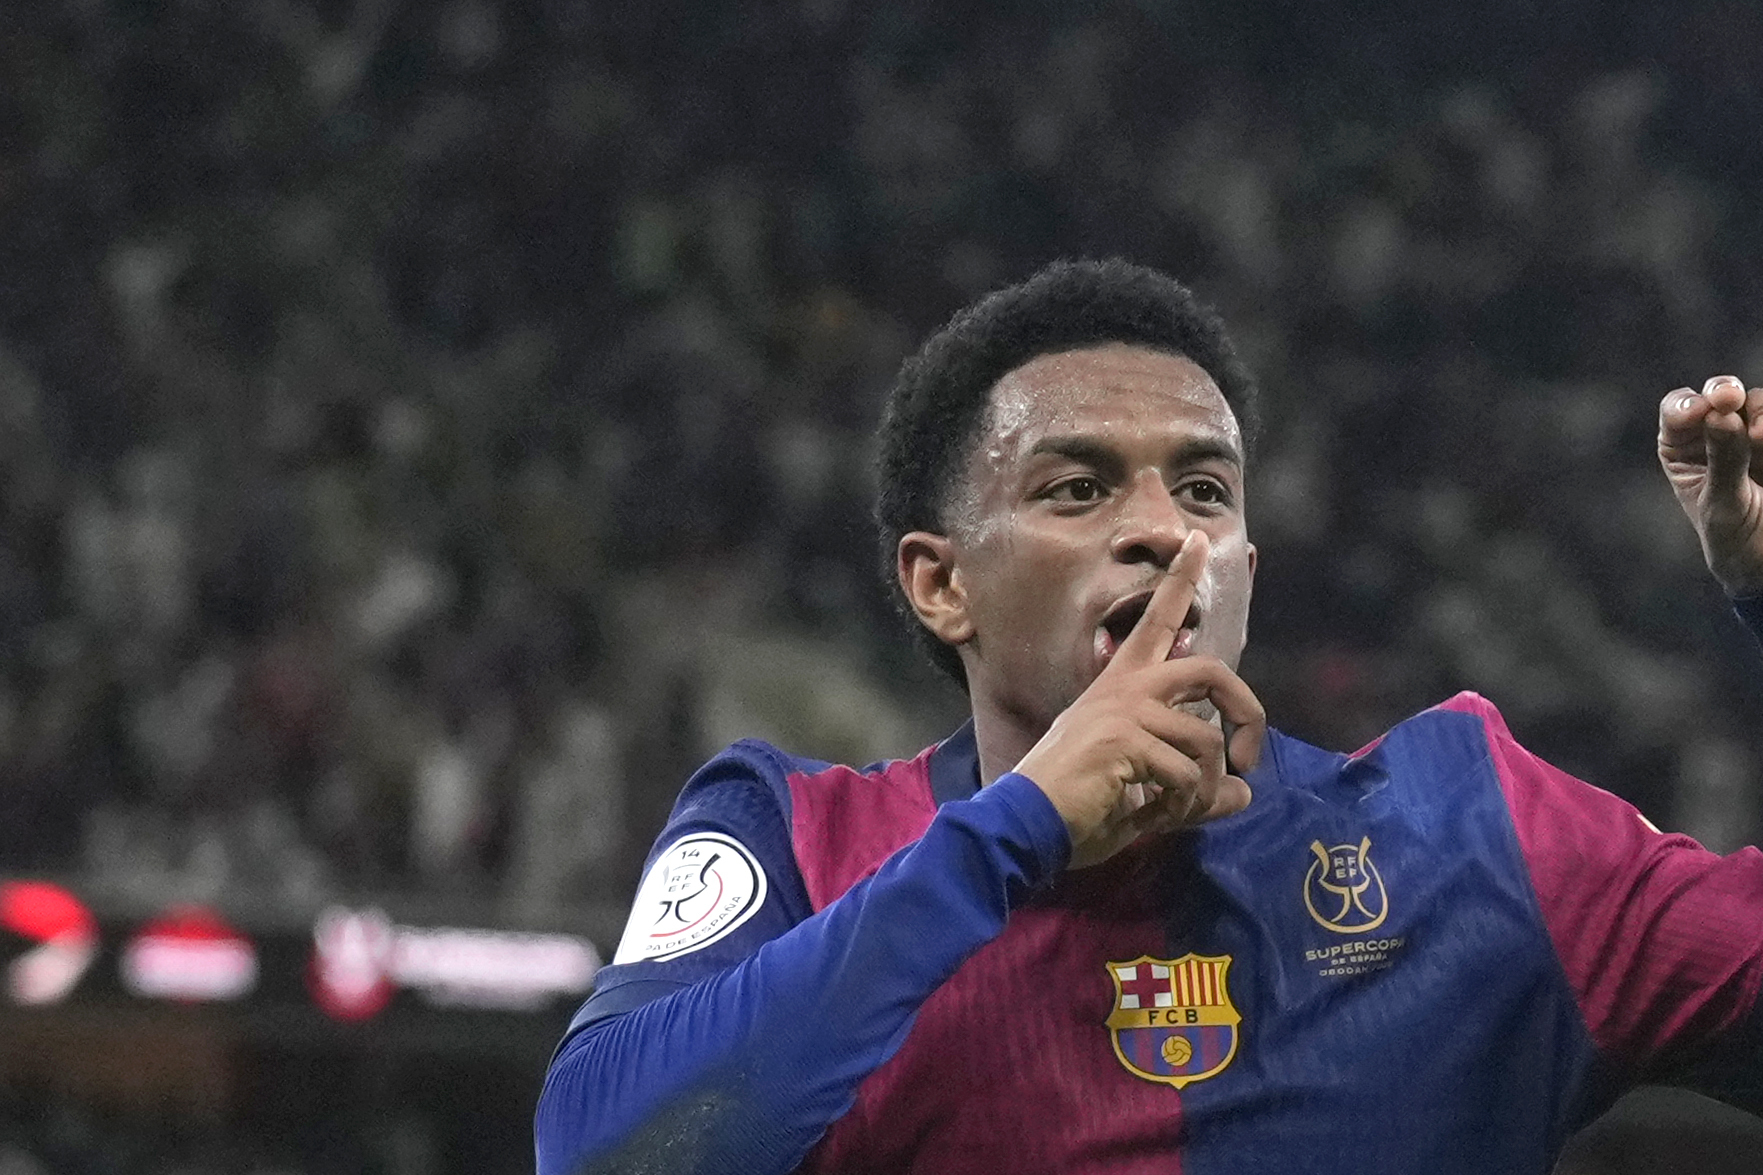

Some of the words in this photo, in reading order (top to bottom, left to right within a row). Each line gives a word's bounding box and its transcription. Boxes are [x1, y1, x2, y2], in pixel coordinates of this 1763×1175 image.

[682, 849, 700, 860] 14
[1305, 939, 1405, 961] SUPERCOPA
[1148, 1009, 1198, 1025] FCB
